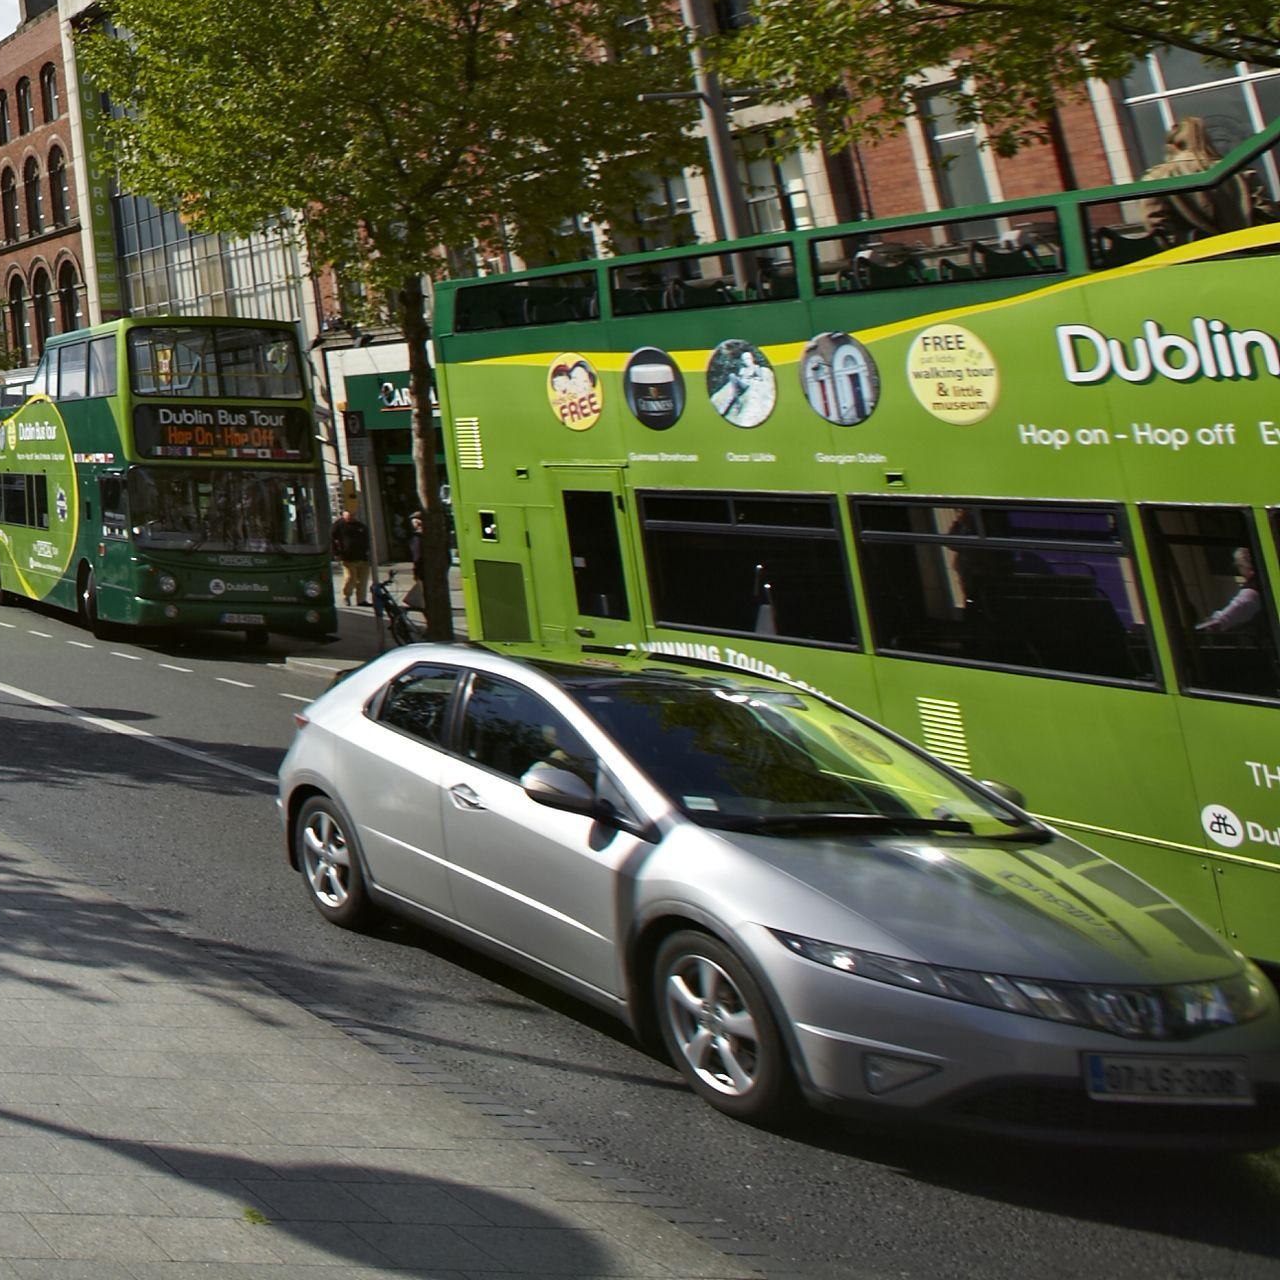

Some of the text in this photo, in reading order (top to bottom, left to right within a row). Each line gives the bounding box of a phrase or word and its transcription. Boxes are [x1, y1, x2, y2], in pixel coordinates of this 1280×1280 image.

[87, 133, 105, 217] TOURS
[922, 335, 965, 351] FREE
[1056, 316, 1280, 384] Dublin
[912, 367, 995, 381] walking tour
[937, 383, 983, 397] & little
[560, 393, 601, 422] FREE
[932, 401, 990, 410] museum
[159, 409, 286, 426] Dublin Bus Tour
[168, 426, 192, 445] Hop
[194, 427, 214, 445] On
[224, 427, 249, 446] Hop
[251, 428, 275, 447] Off
[1018, 424, 1071, 451] Hop
[1075, 427, 1110, 446] on
[1132, 423, 1190, 451] Hop
[1196, 423, 1237, 446] off
[815, 452, 888, 464] Georgian Dublin
[226, 583, 270, 592] Dublin Bus
[1244, 760, 1280, 789] TH
